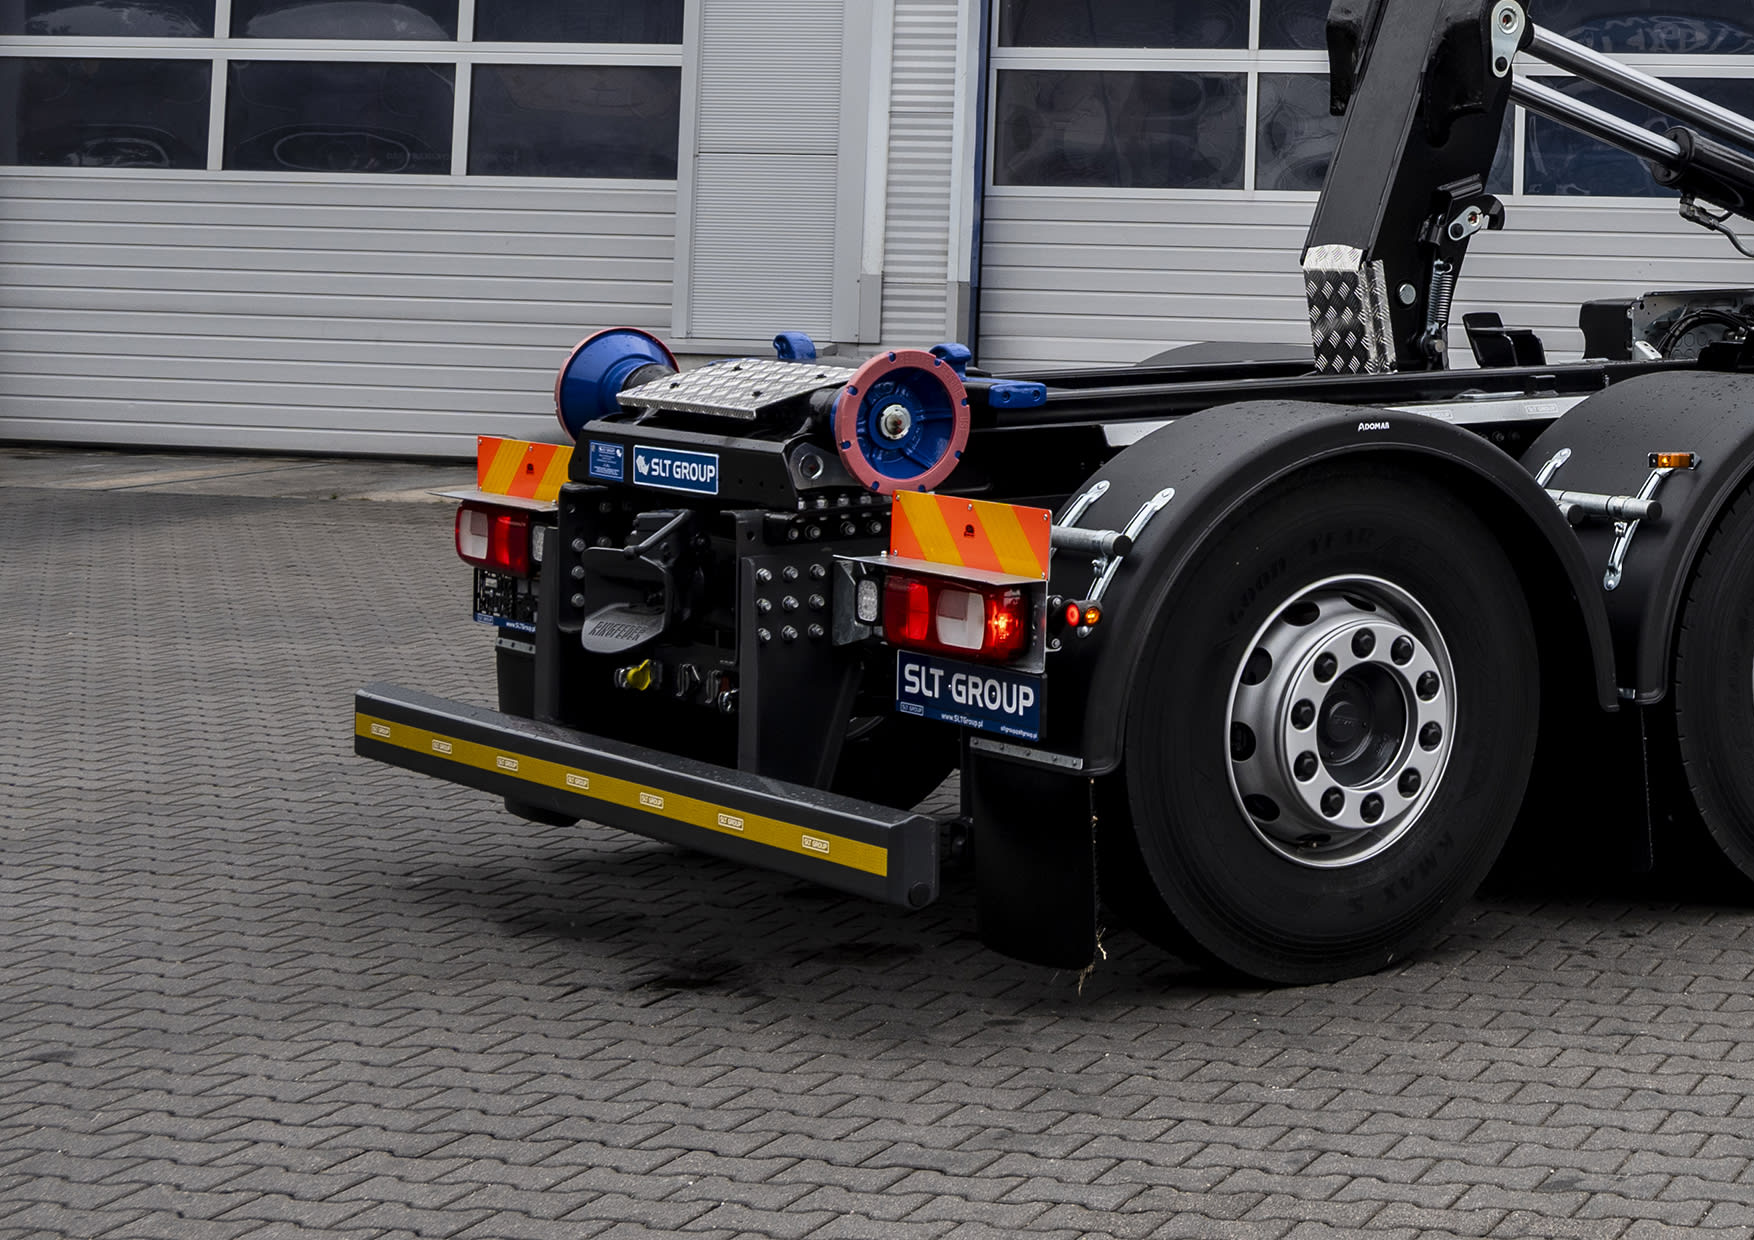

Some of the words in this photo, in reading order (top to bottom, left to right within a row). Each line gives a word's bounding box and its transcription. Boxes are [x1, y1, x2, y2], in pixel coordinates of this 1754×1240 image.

[651, 458, 671, 477] SLT
[672, 461, 716, 483] GROUP
[904, 663, 945, 698] SLT
[951, 672, 1035, 717] GROUP
[941, 713, 984, 729] www.SLTGroup.pl
